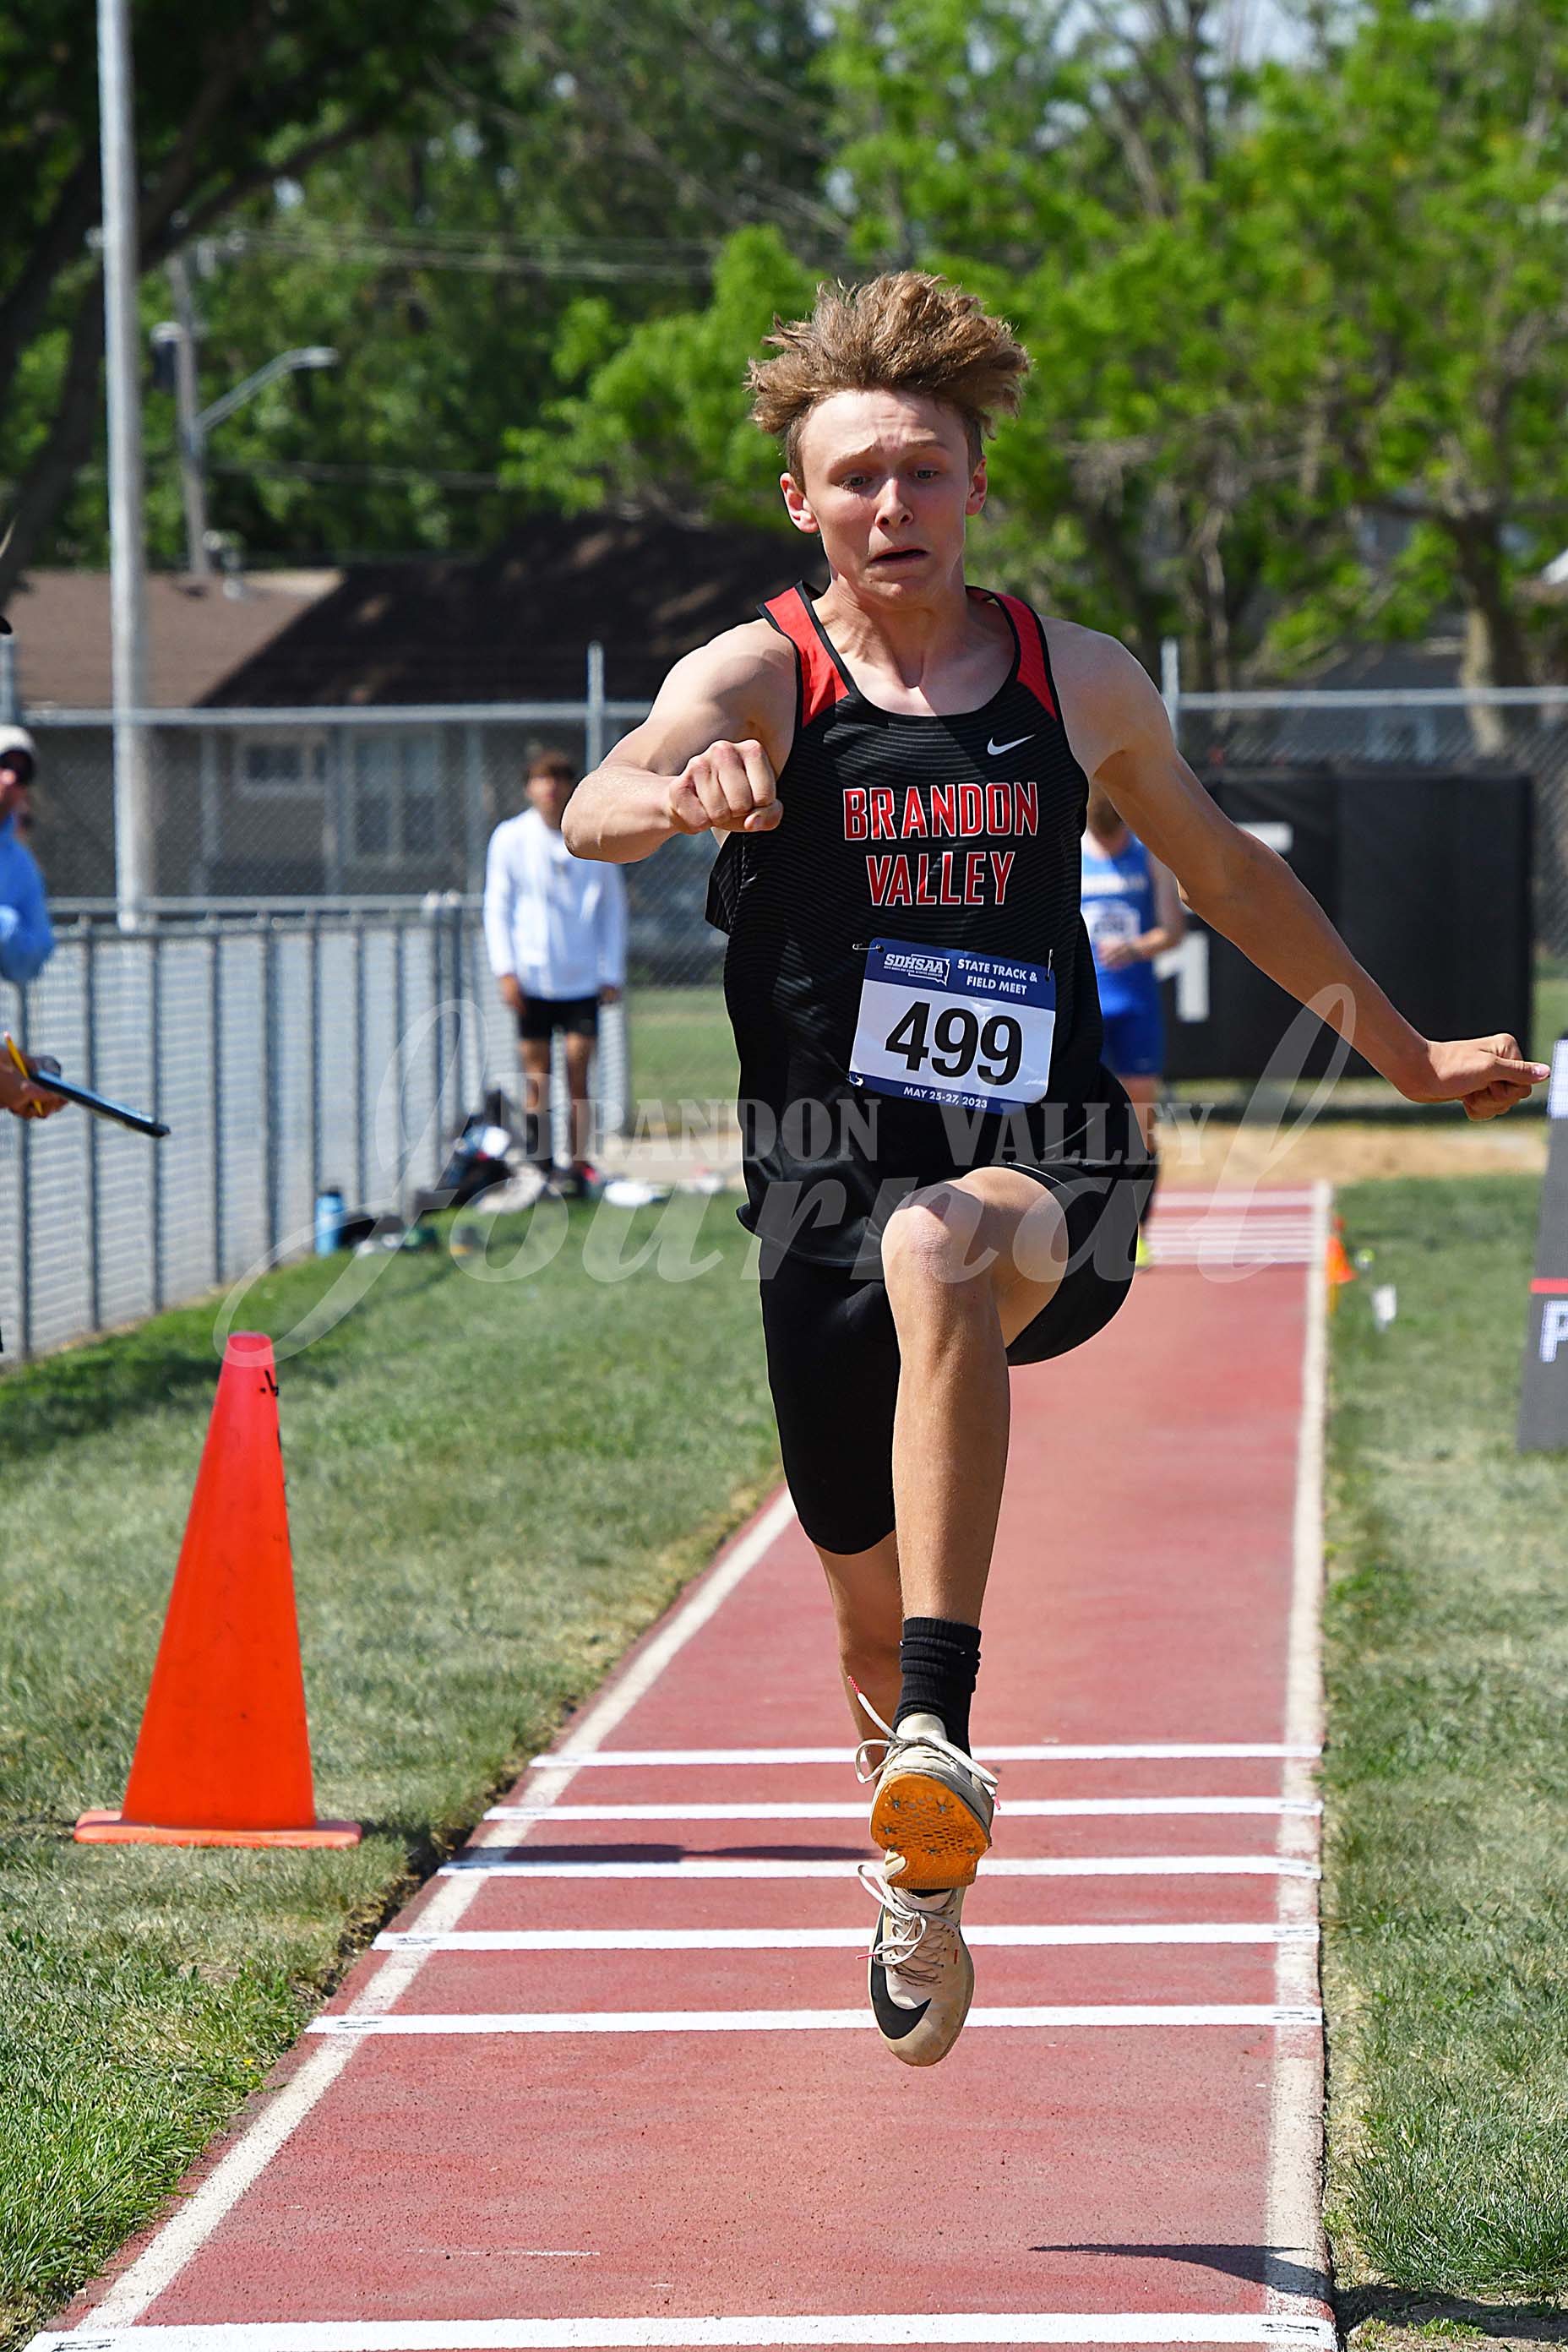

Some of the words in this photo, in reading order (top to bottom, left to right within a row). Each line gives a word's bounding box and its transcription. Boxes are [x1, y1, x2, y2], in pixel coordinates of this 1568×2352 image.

[843, 782, 1038, 840] BRANDON
[866, 852, 1015, 906] VALLEY
[884, 953, 944, 973] SDHSAA
[957, 959, 990, 973] STATE
[992, 965, 1026, 980] TRACK
[1029, 972, 1037, 983] &
[966, 976, 996, 989] FIELD
[999, 981, 1027, 995] MEET
[885, 1000, 1023, 1086] 499
[903, 1086, 928, 1098] MAY
[929, 1092, 959, 1105] 25-27,
[962, 1097, 988, 1108] 2023
